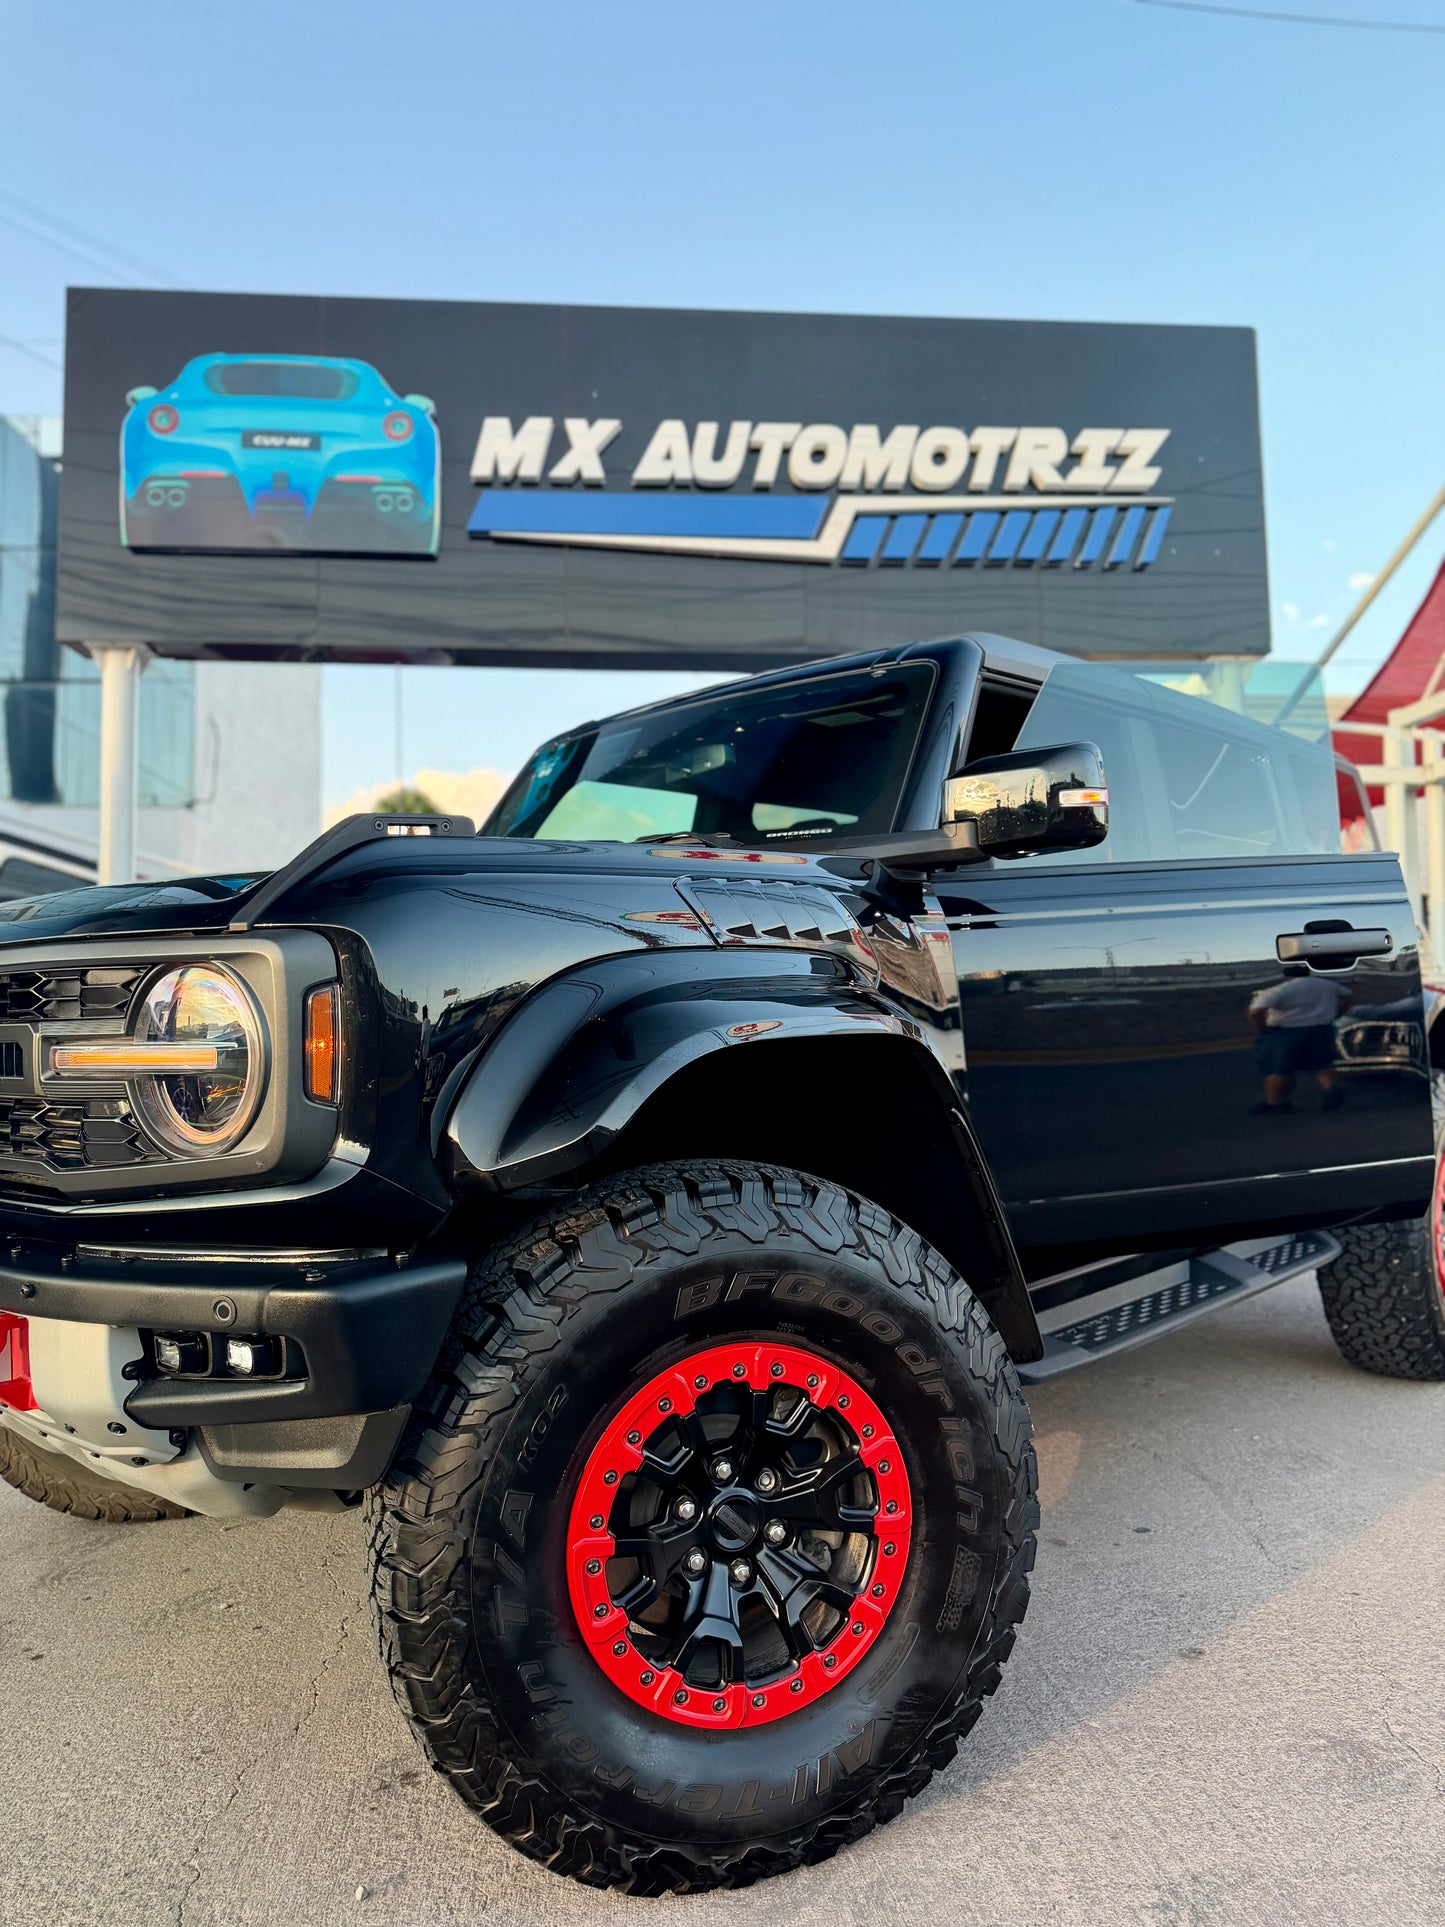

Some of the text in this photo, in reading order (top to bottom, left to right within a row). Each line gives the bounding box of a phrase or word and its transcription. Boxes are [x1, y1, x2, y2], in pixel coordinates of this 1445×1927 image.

[469, 416, 1172, 494] MX AUTOMOTRIZ
[766, 827, 833, 838] BRONCO
[673, 1269, 984, 1532] BFGoodrich
[722, 1511, 749, 1537] FORD
[493, 1490, 534, 1637] T/A
